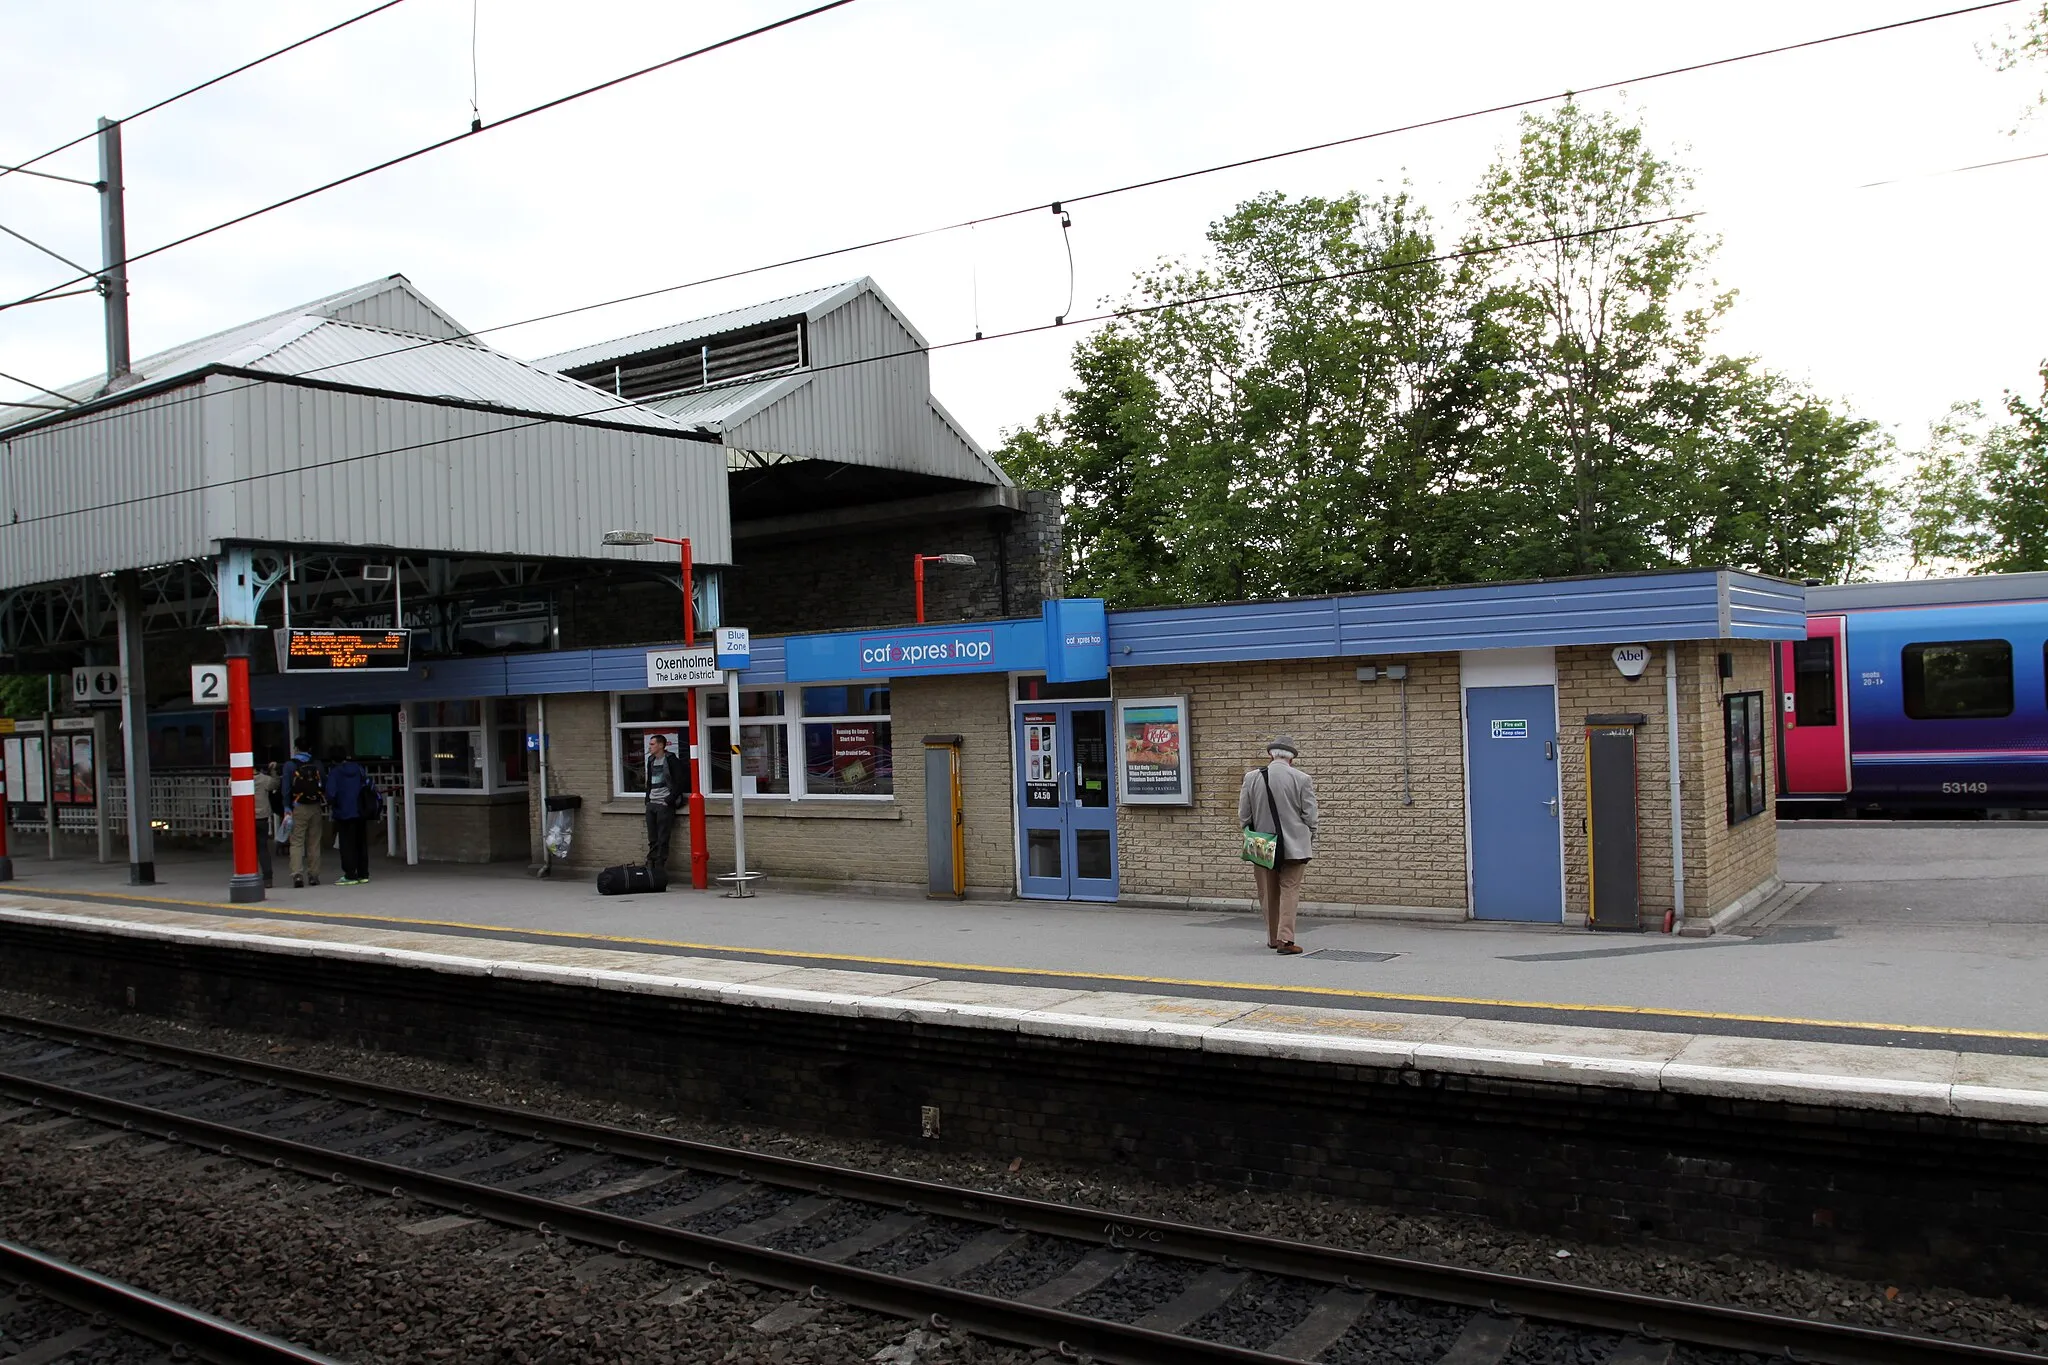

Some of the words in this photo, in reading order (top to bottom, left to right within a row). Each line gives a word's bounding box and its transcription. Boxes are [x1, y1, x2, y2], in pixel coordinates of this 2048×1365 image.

[365, 614, 392, 628] THE
[728, 630, 745, 640] Blue
[727, 642, 747, 651] Zone
[1617, 649, 1644, 662] Abel
[655, 655, 714, 670] Oxenholme
[656, 672, 669, 681] The
[670, 671, 687, 681] Lake
[689, 670, 715, 680] District
[201, 672, 218, 698] 2
[1863, 678, 1880, 686] 20-1
[1942, 782, 1988, 794] 53149
[1033, 791, 1051, 800] £4.50
